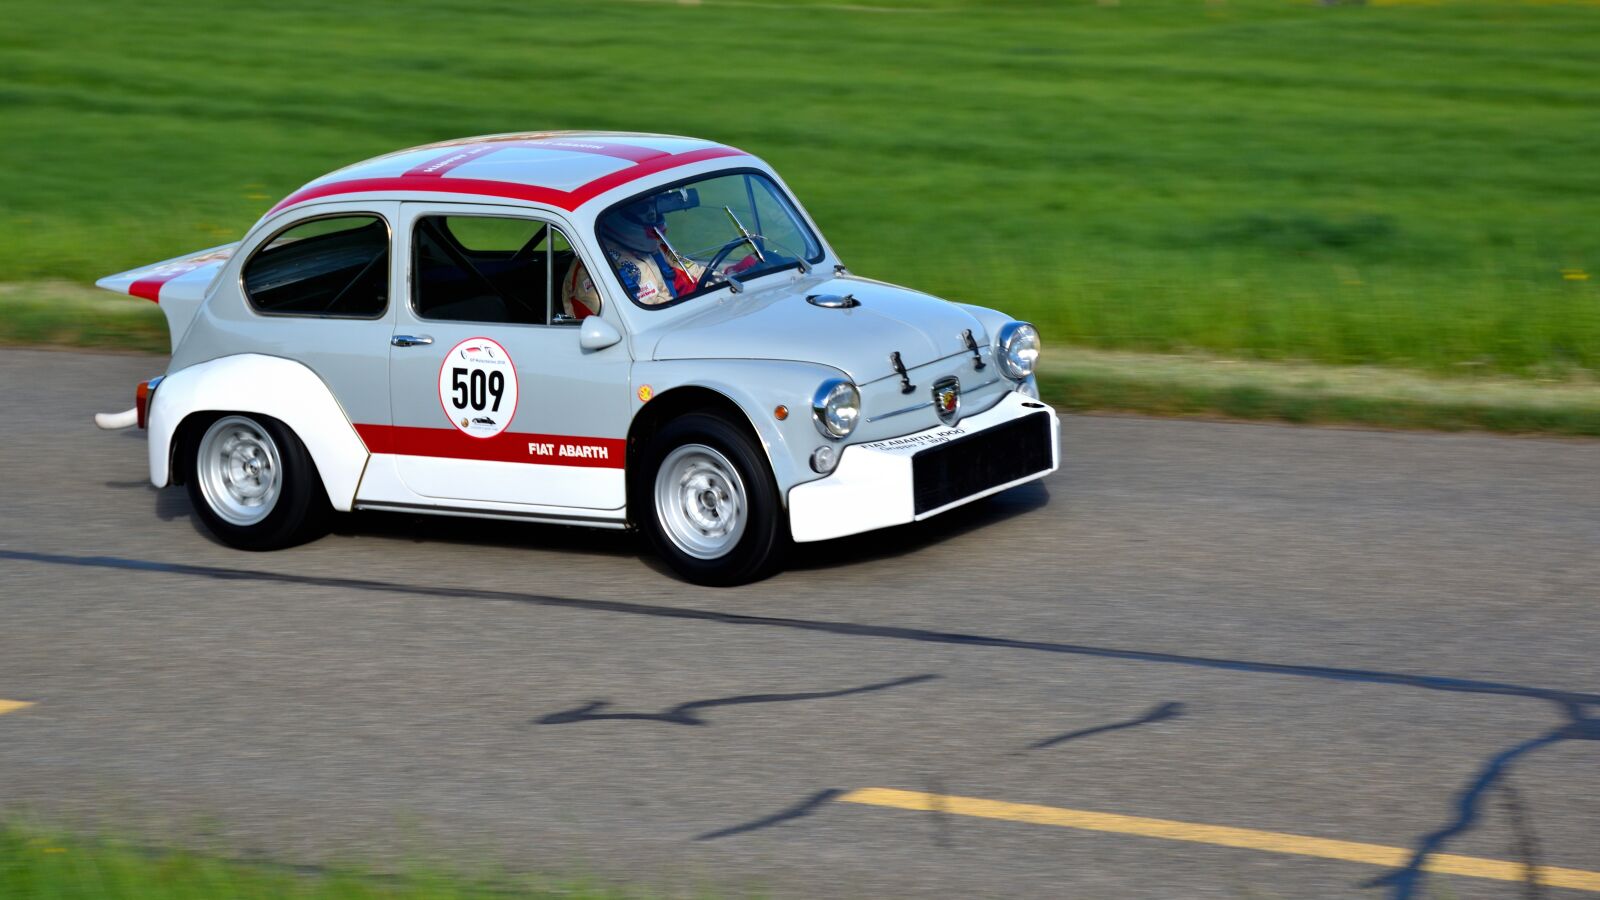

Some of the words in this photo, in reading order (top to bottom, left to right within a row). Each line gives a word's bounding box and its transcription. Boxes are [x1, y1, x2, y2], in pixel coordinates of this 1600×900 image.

[452, 367, 505, 412] 509
[888, 434, 934, 446] ABARTH
[528, 442, 555, 456] FIAT
[558, 444, 609, 459] ABARTH
